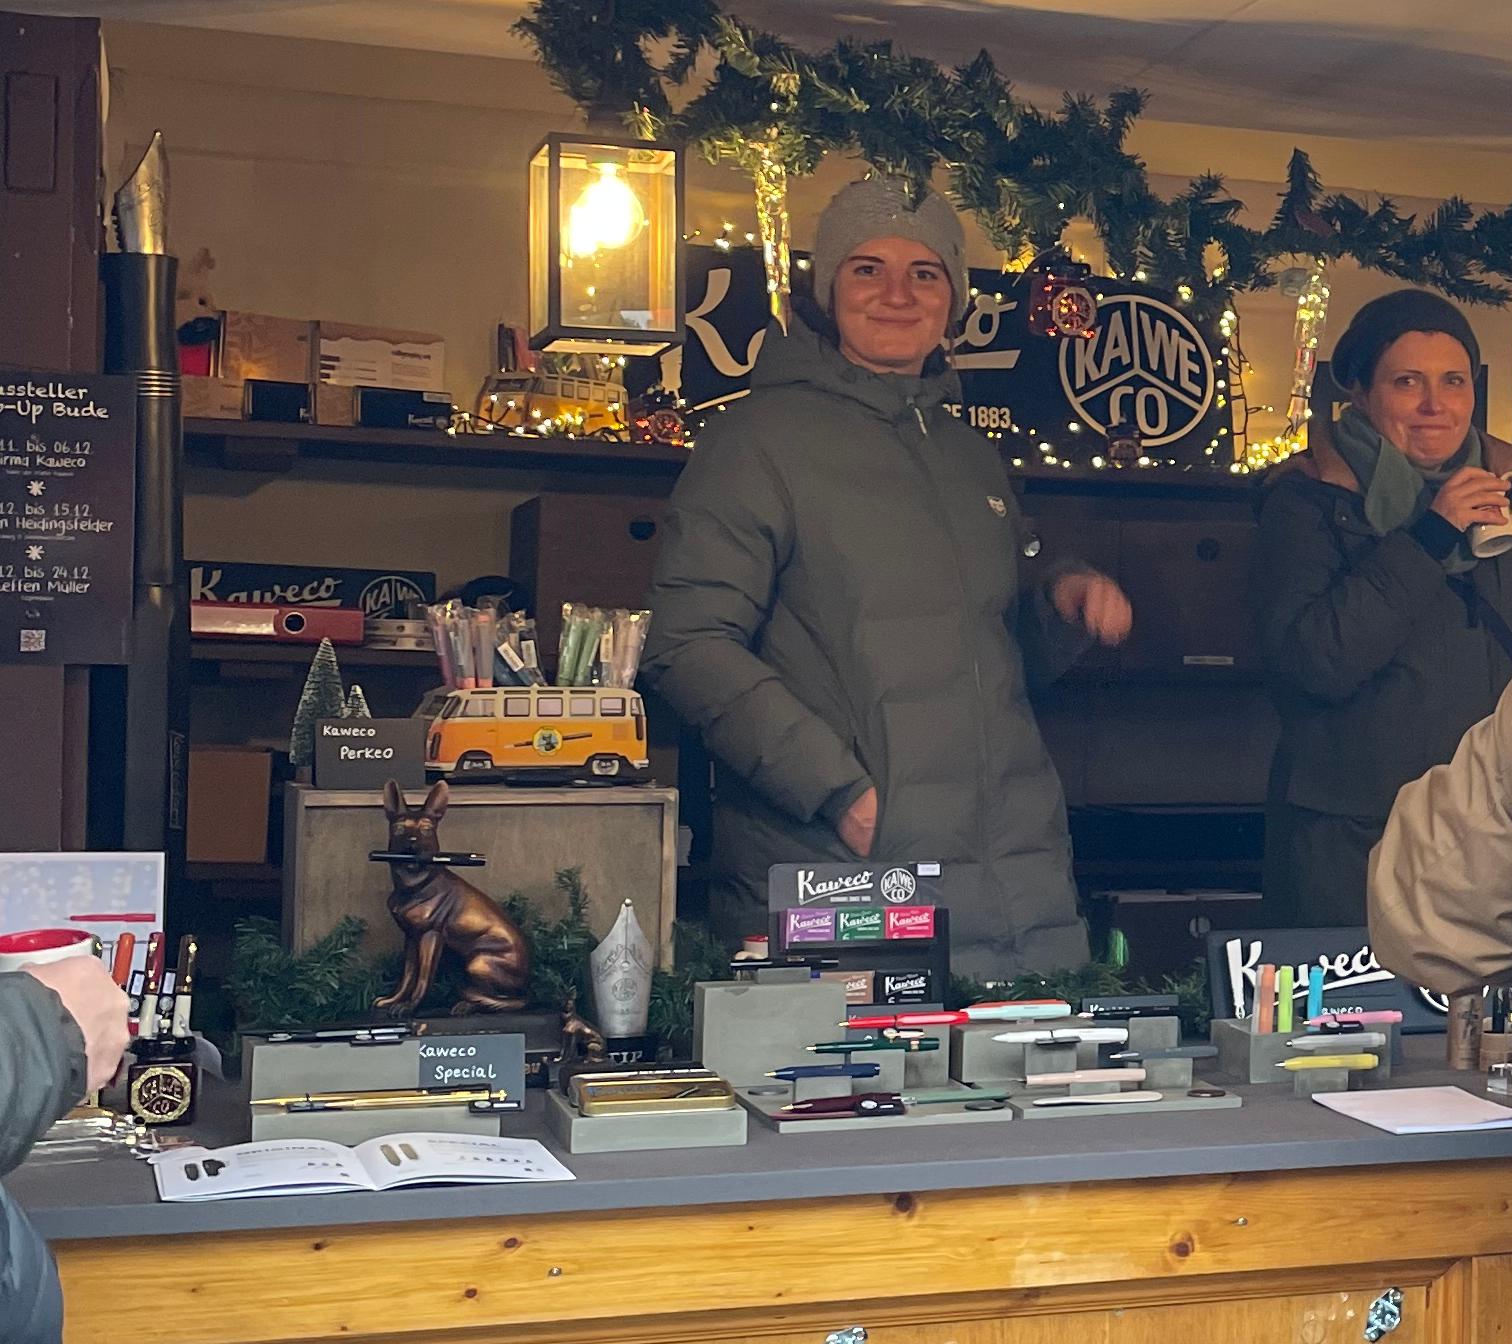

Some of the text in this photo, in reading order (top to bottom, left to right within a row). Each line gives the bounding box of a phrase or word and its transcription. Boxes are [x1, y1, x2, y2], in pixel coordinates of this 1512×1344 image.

[53, 401, 109, 418] Bude
[968, 405, 1011, 429] 1883
[26, 440, 47, 453] bis
[36, 455, 86, 468] Kaweco
[25, 503, 45, 516] bis
[16, 517, 114, 537] Heidingsfelder
[24, 566, 45, 578] bis
[47, 580, 90, 594] Müller
[323, 725, 377, 737] Kaweco
[797, 870, 874, 904] Kaweco
[790, 913, 832, 932] Kaweco
[840, 912, 881, 932] Kaweco
[889, 912, 930, 932] Kaweco
[885, 976, 927, 996] Kaweco
[1321, 1006, 1363, 1015] aweco
[434, 1064, 497, 1084] Special
